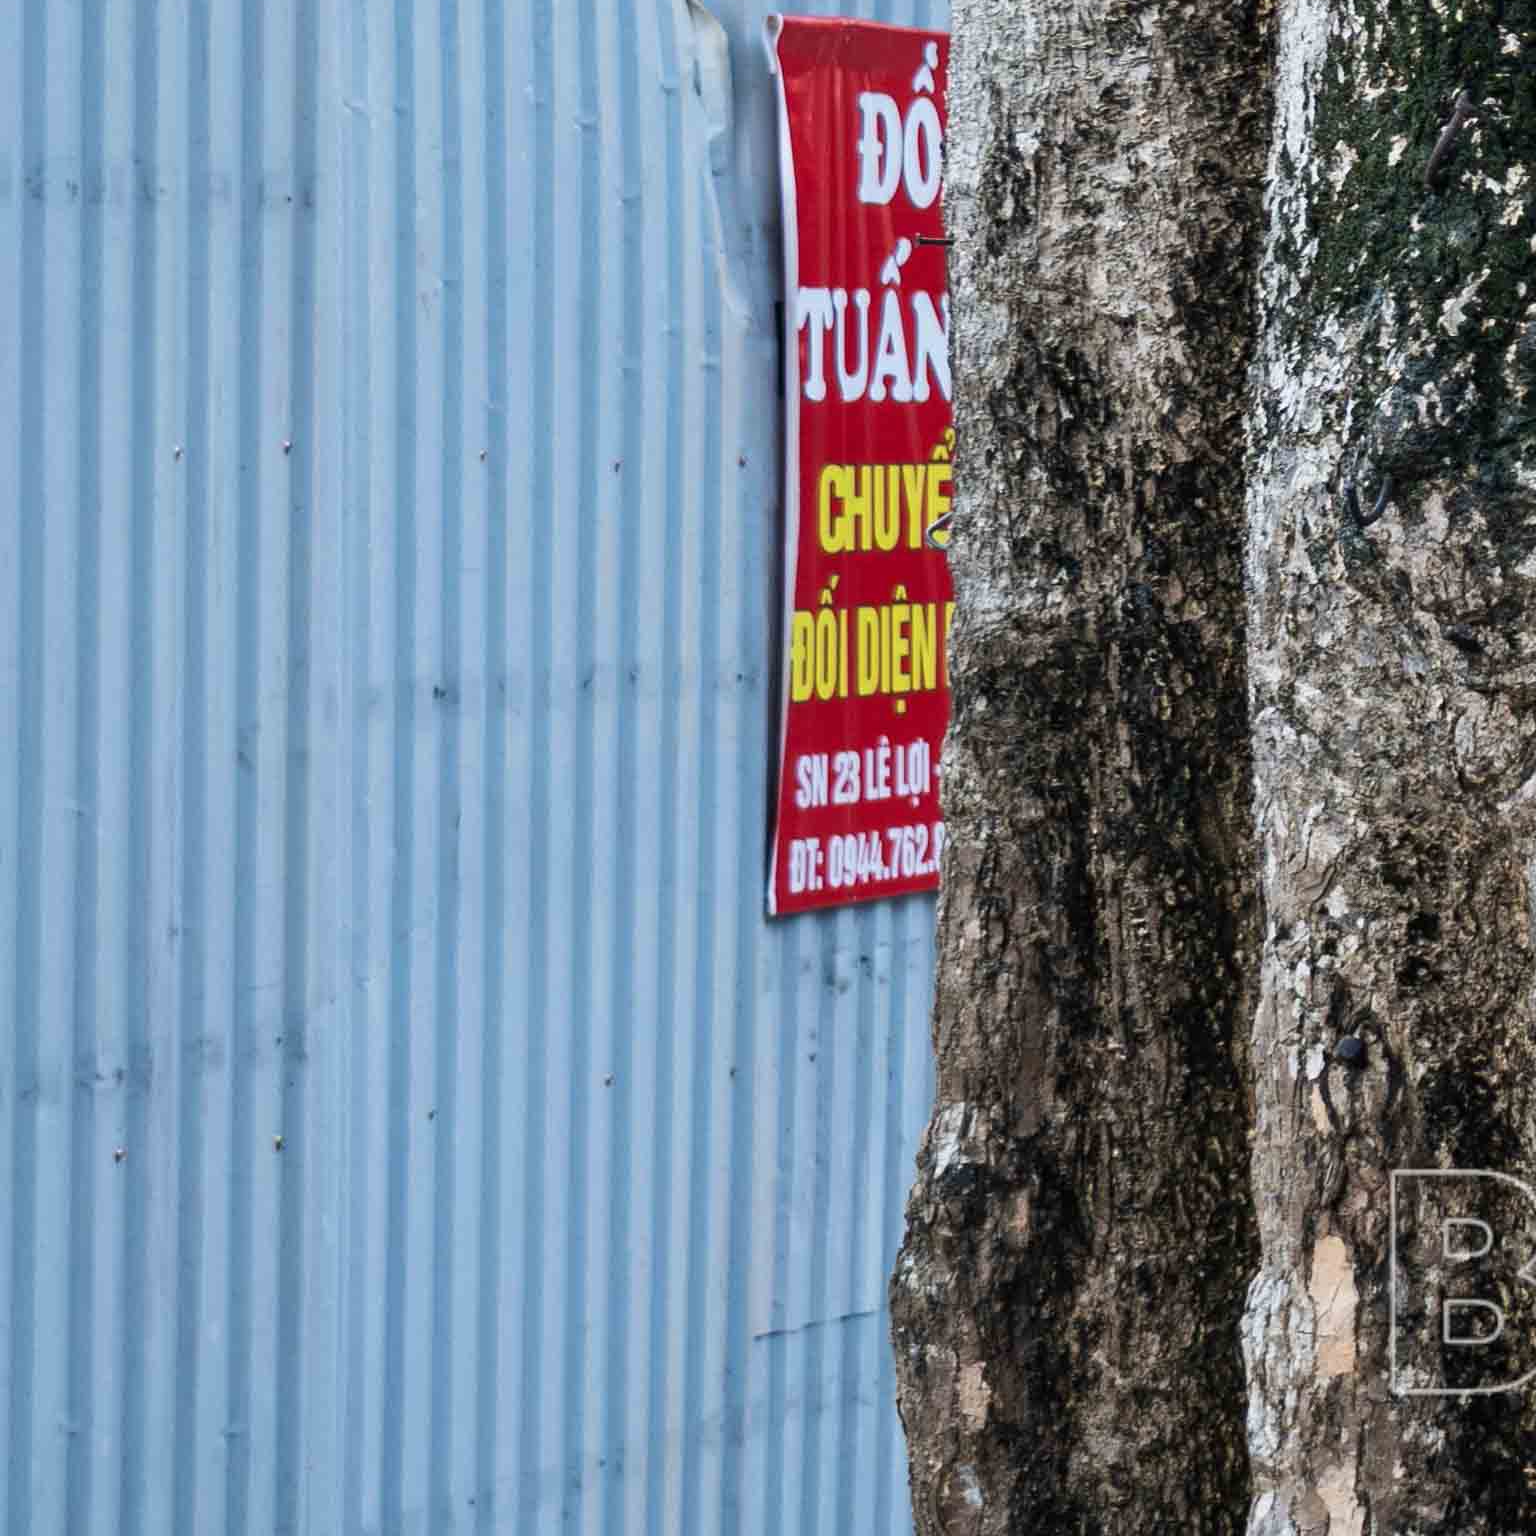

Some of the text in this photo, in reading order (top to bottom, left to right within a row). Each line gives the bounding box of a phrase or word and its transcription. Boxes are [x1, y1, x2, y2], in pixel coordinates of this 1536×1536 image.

[857, 583, 937, 714] DIỆN
[795, 754, 829, 809] SN
[832, 750, 861, 806] 23
[864, 734, 891, 801] LÊ
[895, 737, 931, 808] LỢI
